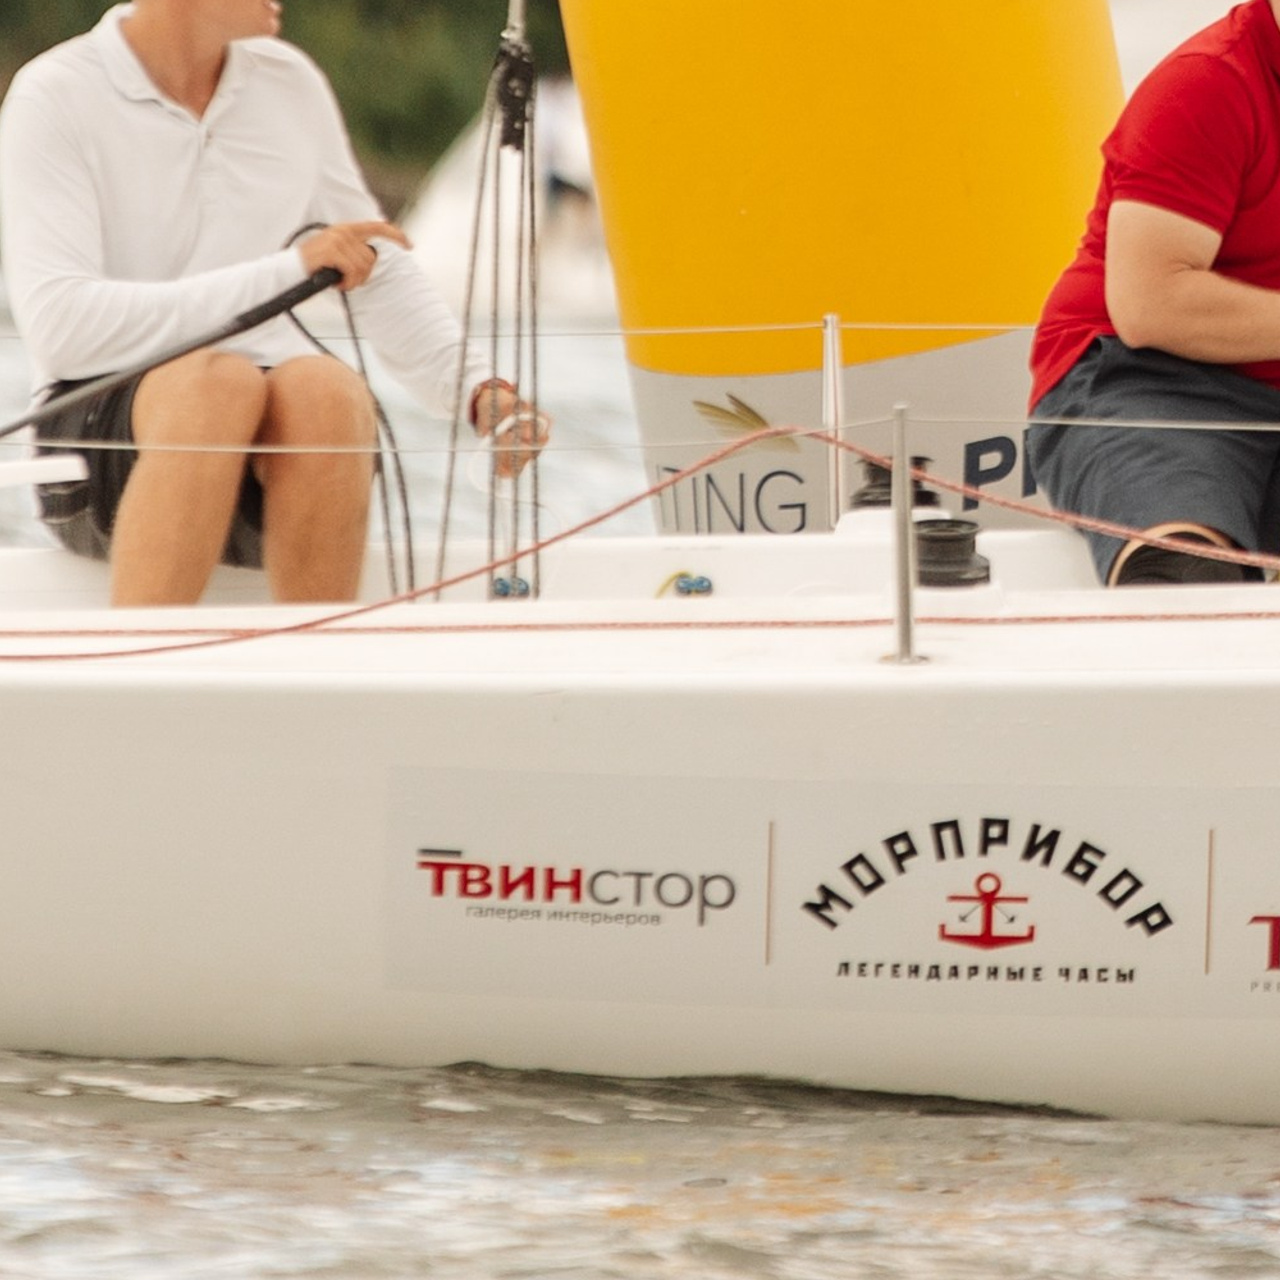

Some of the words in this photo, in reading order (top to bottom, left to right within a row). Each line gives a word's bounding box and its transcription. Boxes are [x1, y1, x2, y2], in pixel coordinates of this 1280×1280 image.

[962, 428, 1037, 512] P
[802, 817, 1174, 938] МОРПРИБОР
[465, 905, 541, 922] галерея
[546, 908, 662, 927] интерьеров
[836, 962, 1044, 983] ЛЕГЕНДАРНЫЕ
[1057, 966, 1136, 984] ЧАСЫ
